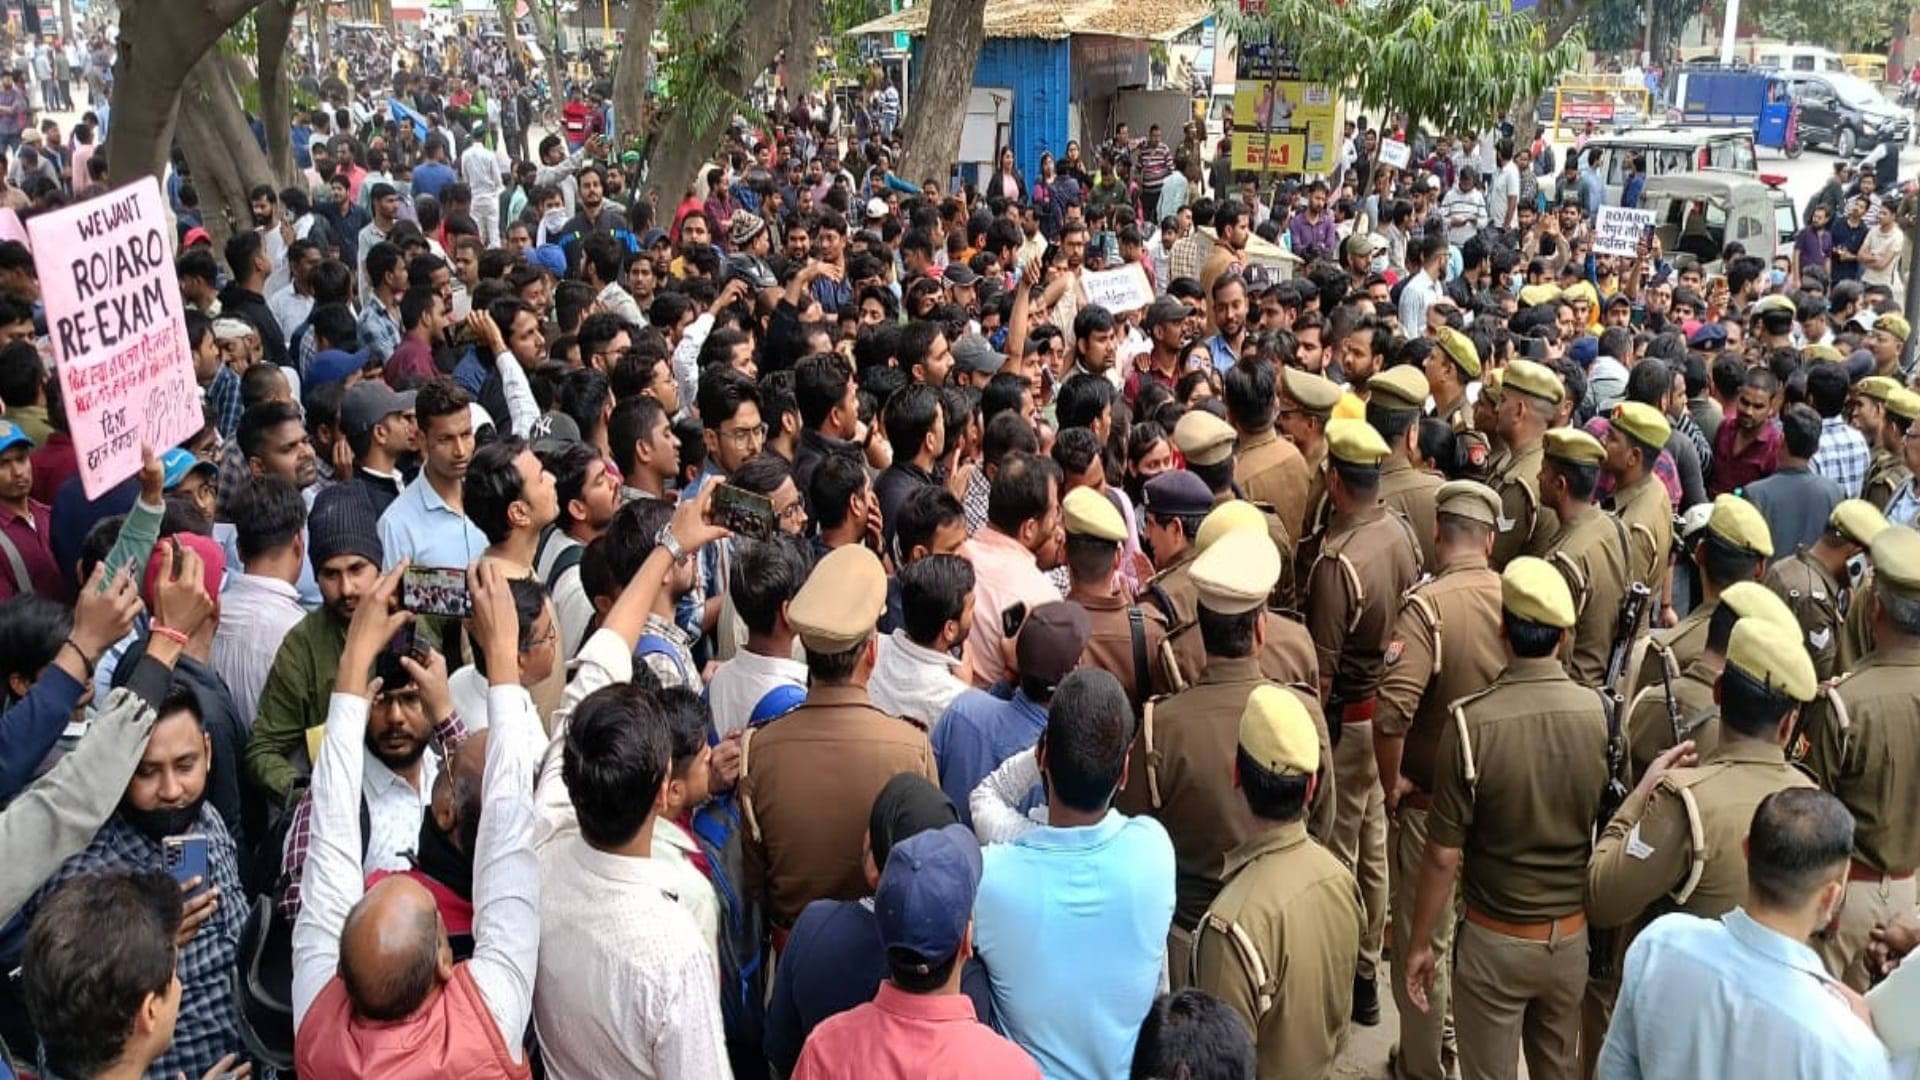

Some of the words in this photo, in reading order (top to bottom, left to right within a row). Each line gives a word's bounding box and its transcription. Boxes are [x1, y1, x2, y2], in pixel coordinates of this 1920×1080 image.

[77, 210, 103, 242] WE
[101, 193, 141, 232] WANT
[1605, 210, 1650, 224] RO/ARO
[71, 228, 163, 302] RO/ARO
[57, 277, 169, 362] RE-EXAM
